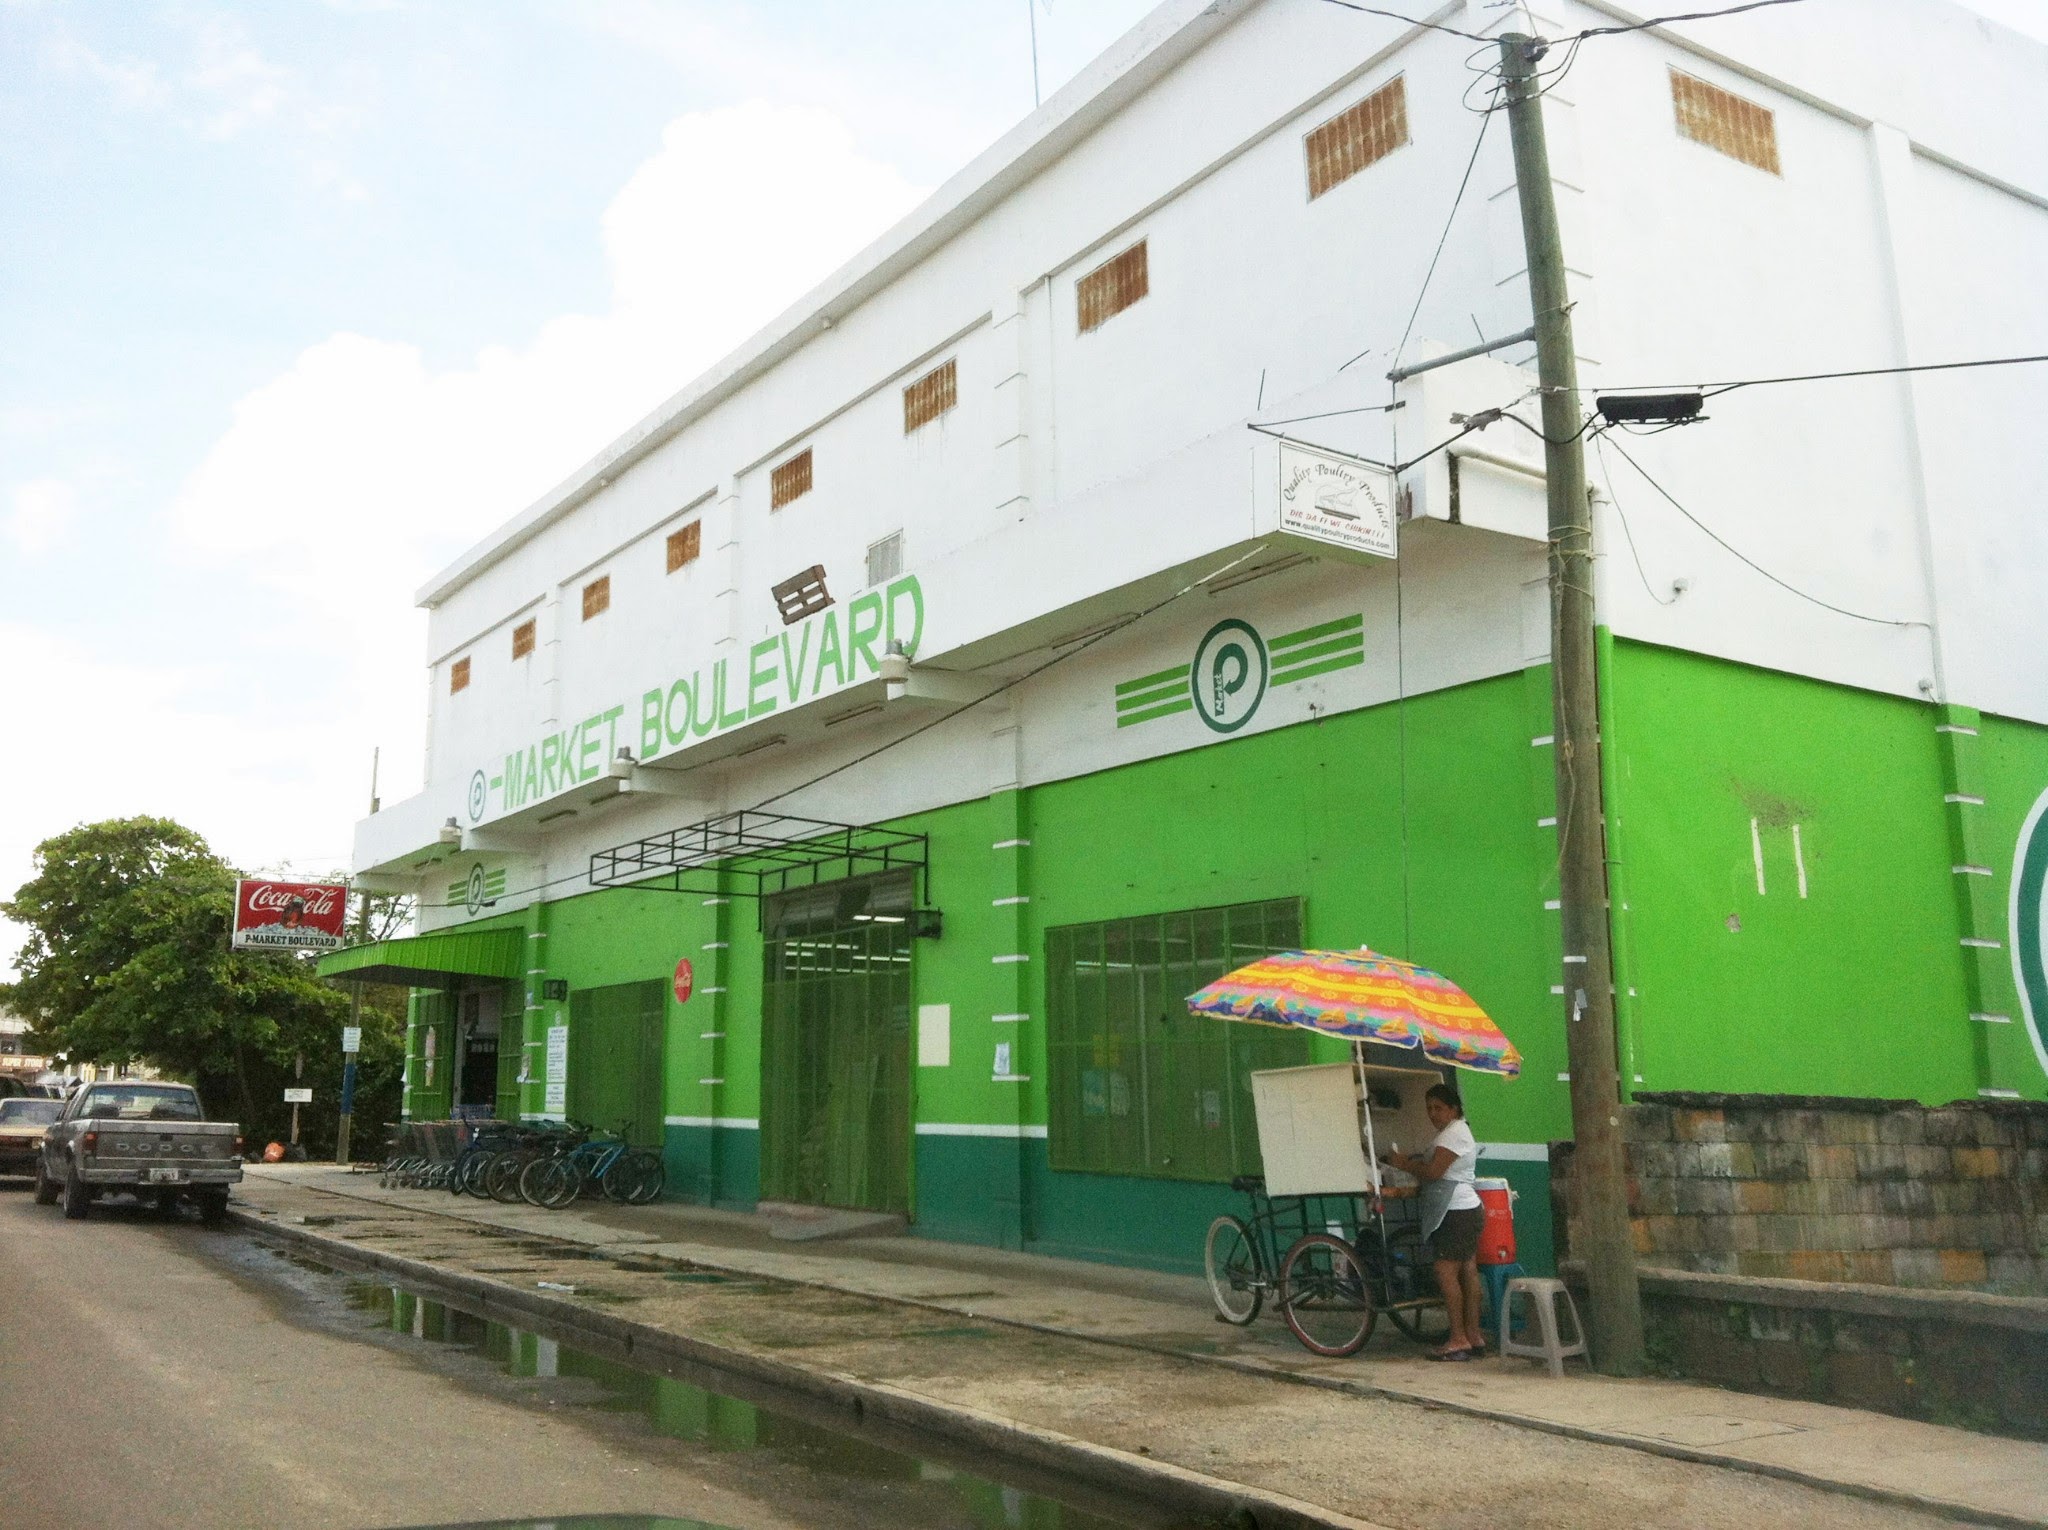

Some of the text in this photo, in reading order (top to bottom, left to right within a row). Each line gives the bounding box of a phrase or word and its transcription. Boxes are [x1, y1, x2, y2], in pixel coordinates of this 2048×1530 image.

[1283, 463, 1390, 529] Quality Poultry Products
[1284, 519, 1390, 549] www.qualitypoultryproducts.com
[640, 574, 924, 760] BOULEVARD
[245, 934, 336, 947] P-MARKET BOULEVARD
